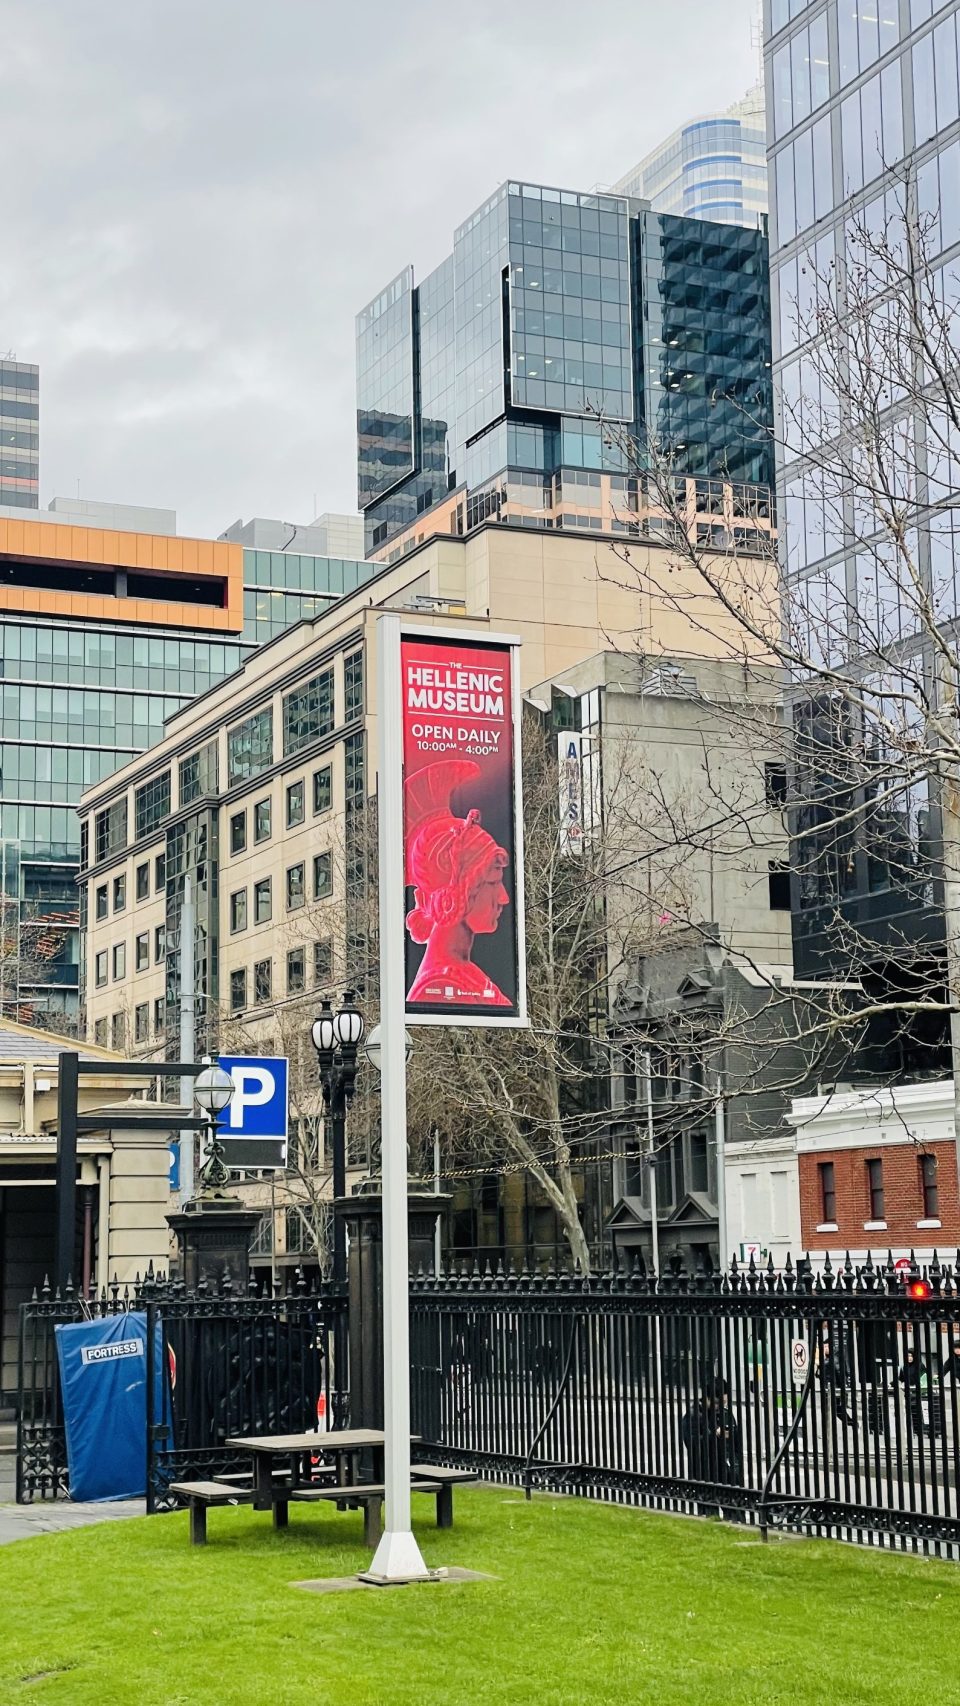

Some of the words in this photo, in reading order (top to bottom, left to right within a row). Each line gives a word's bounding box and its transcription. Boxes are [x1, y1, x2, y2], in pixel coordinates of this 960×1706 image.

[407, 667, 503, 693] HELLENIC
[407, 688, 504, 715] MUSEUM
[412, 724, 453, 740] OPEN
[458, 728, 500, 744] DAILY
[417, 741, 457, 752] 10:00AM
[465, 745, 499, 755] 4:00PM
[230, 1066, 276, 1128] P
[88, 1343, 137, 1360] FORTRESS
